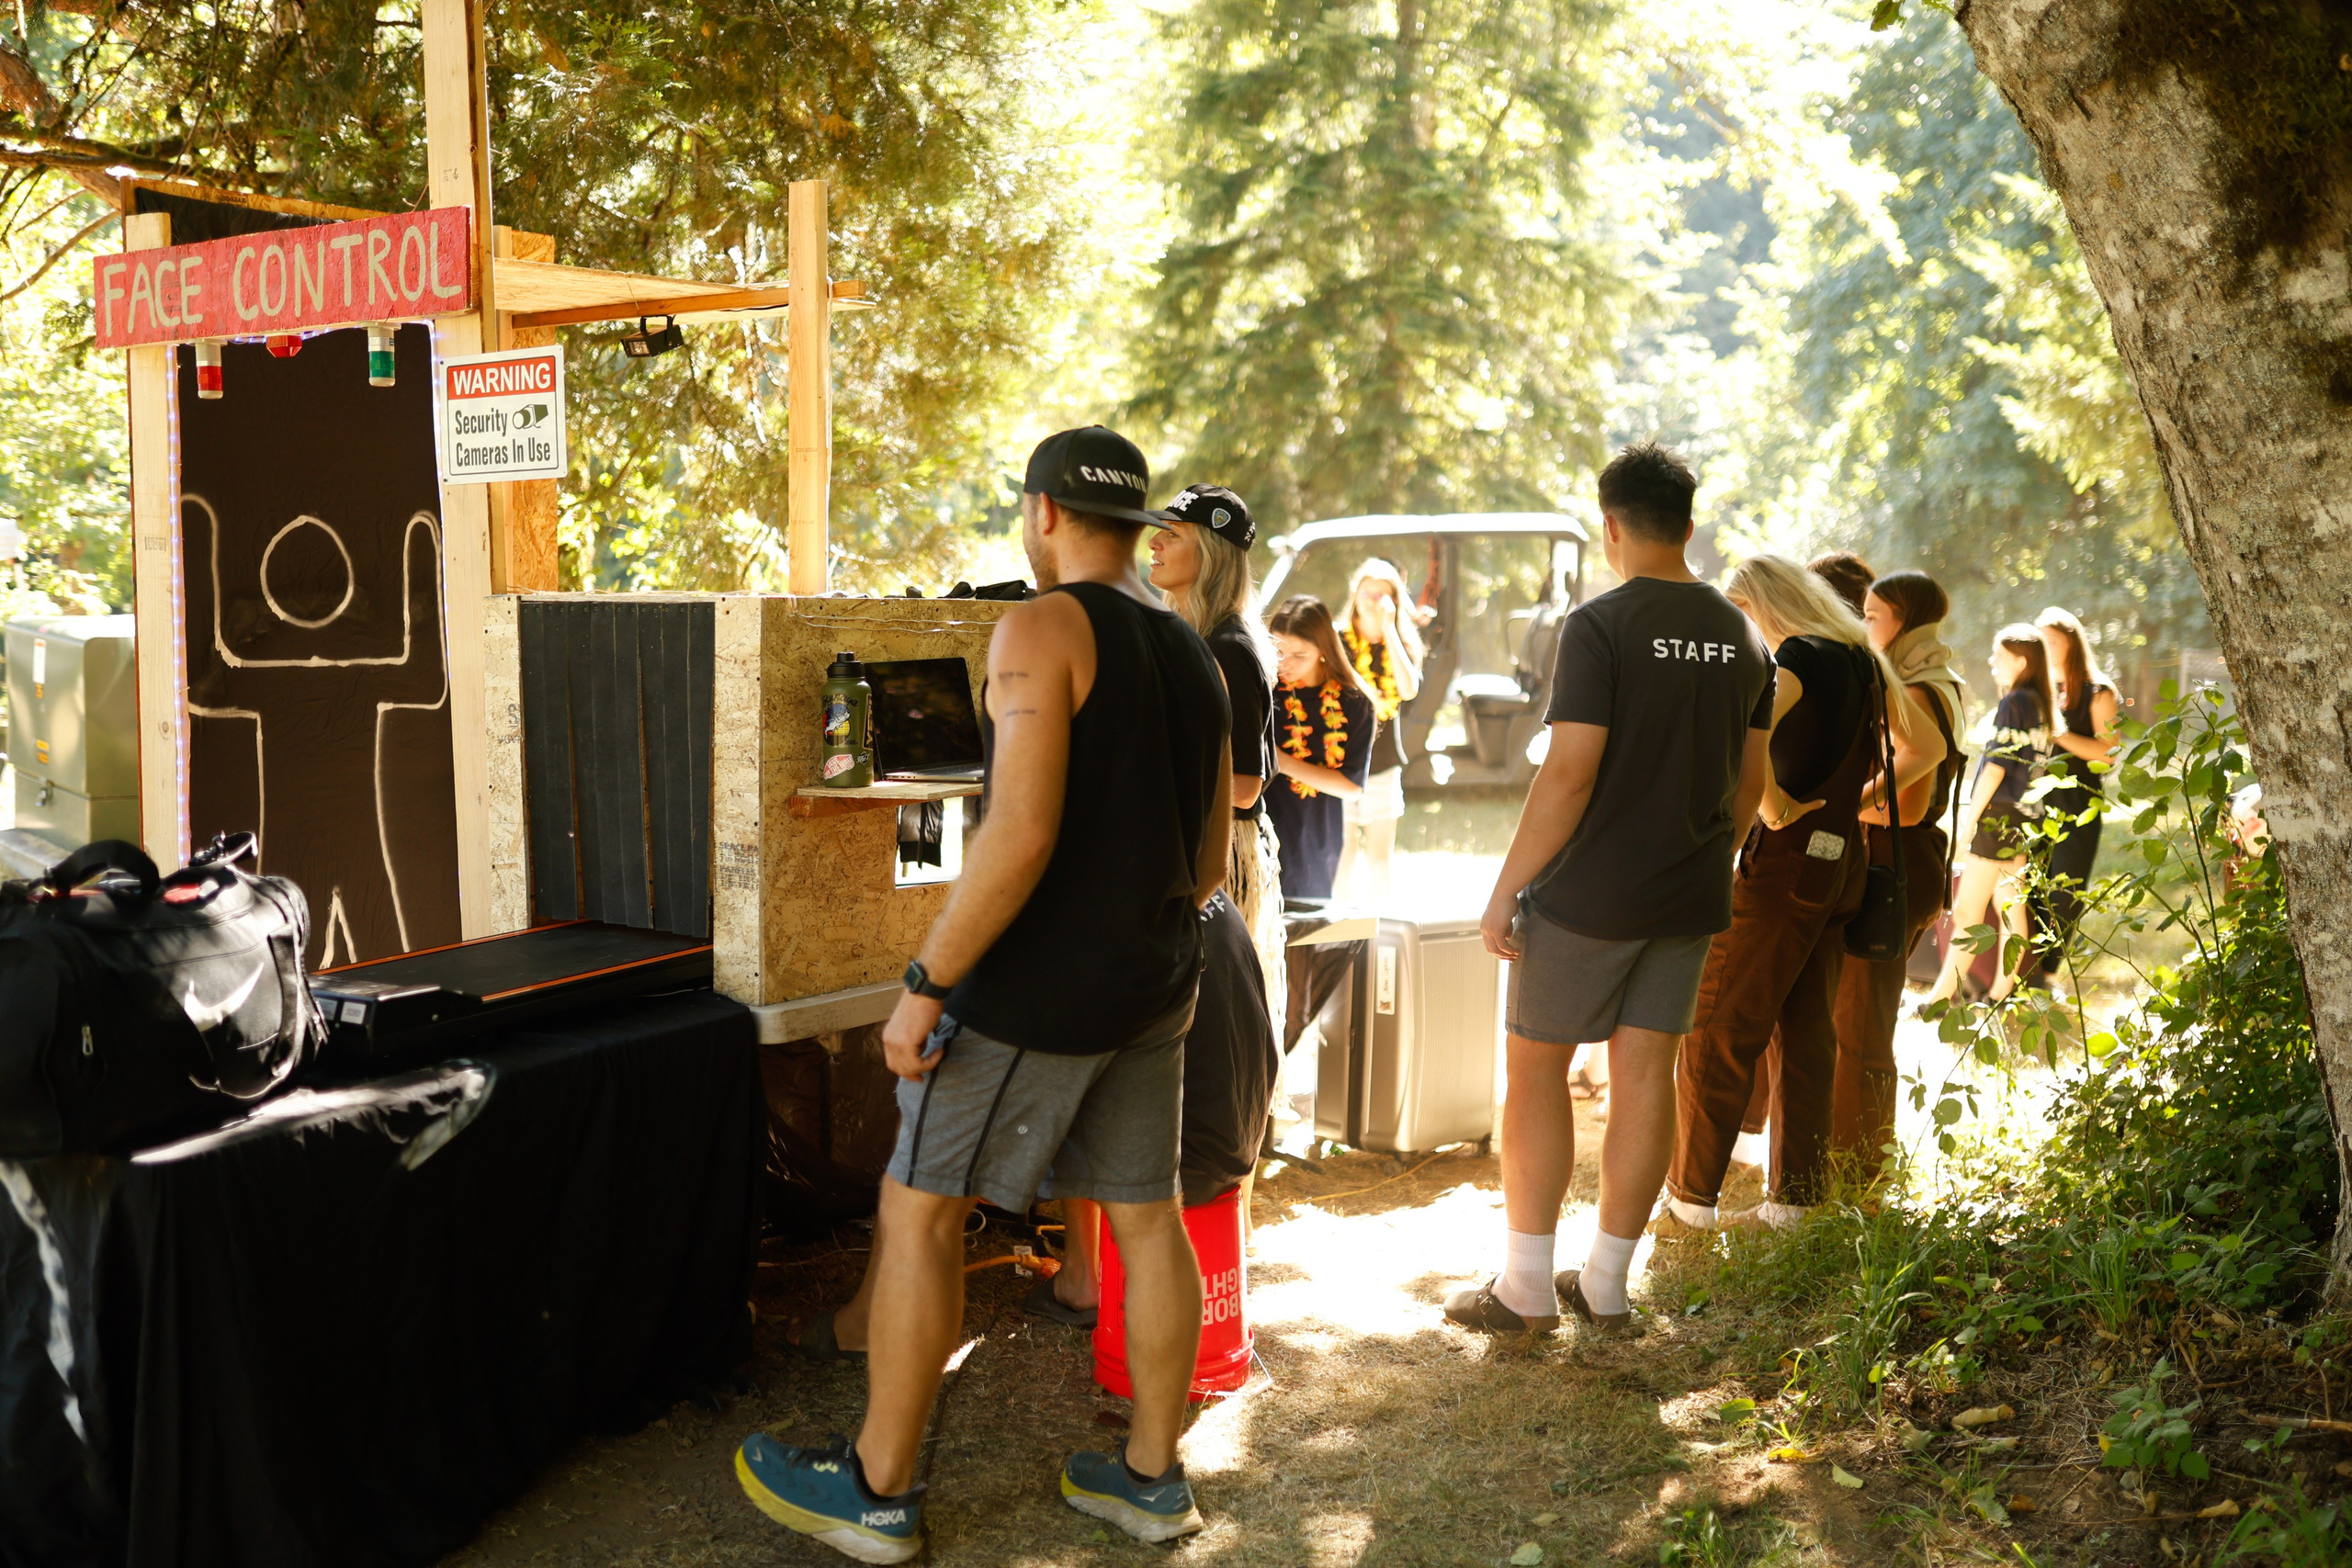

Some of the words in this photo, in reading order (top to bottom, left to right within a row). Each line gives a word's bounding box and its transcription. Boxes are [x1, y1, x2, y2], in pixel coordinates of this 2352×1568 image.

[103, 256, 203, 337] FACE
[233, 221, 462, 321] CONTROL
[453, 363, 551, 396] WARNING
[455, 407, 508, 437] Security
[456, 442, 509, 467] Cameras
[513, 438, 525, 463] In
[527, 436, 550, 462] Use
[1079, 465, 1148, 493] CANYON
[1653, 638, 1736, 663] STAFF
[1202, 1268, 1239, 1300] GHT
[1202, 1292, 1240, 1326] BOR
[861, 1508, 907, 1527] HOKA
